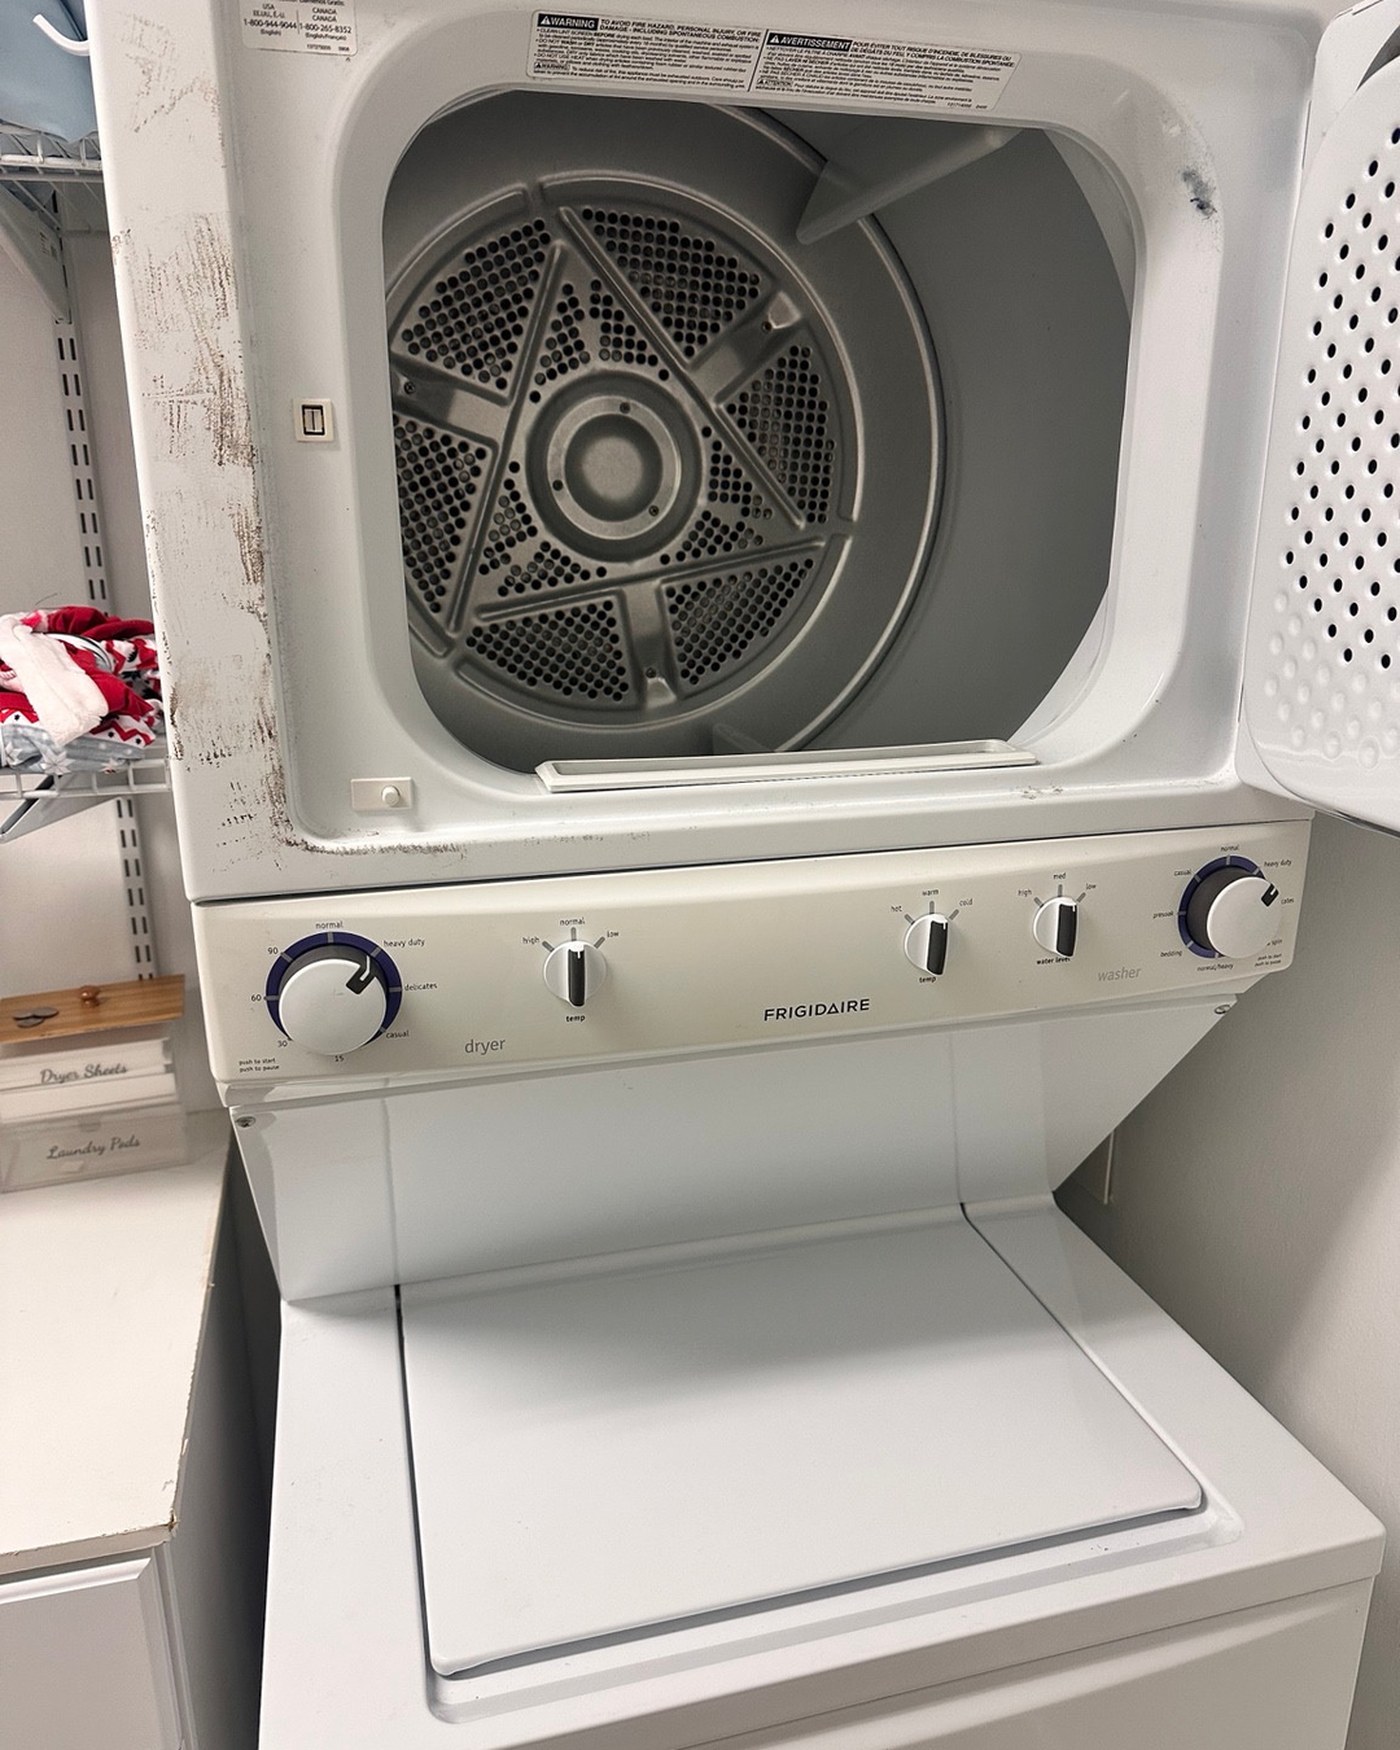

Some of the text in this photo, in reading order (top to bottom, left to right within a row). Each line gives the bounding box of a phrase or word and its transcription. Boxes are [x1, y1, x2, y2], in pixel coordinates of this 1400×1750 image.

[550, 17, 595, 28] WARNING
[669, 30, 715, 39] SPONTANEOUS
[781, 36, 850, 49] AVERTISSEMENT
[1018, 889, 1032, 897] high
[959, 898, 973, 906] cold
[316, 920, 344, 929] normal
[560, 916, 586, 926] normal
[384, 938, 426, 948] heavy duty
[522, 936, 540, 944] high
[1098, 966, 1142, 981] washer
[919, 976, 936, 984] temp
[404, 982, 438, 991] delicates
[764, 998, 870, 1021] FRIGIDAIRE
[566, 1014, 586, 1022] temp
[386, 1030, 410, 1039] casual
[464, 1038, 506, 1055] dryer
[40, 1064, 128, 1084] Dryer Sheets
[46, 1134, 140, 1160] Laundry Pods
